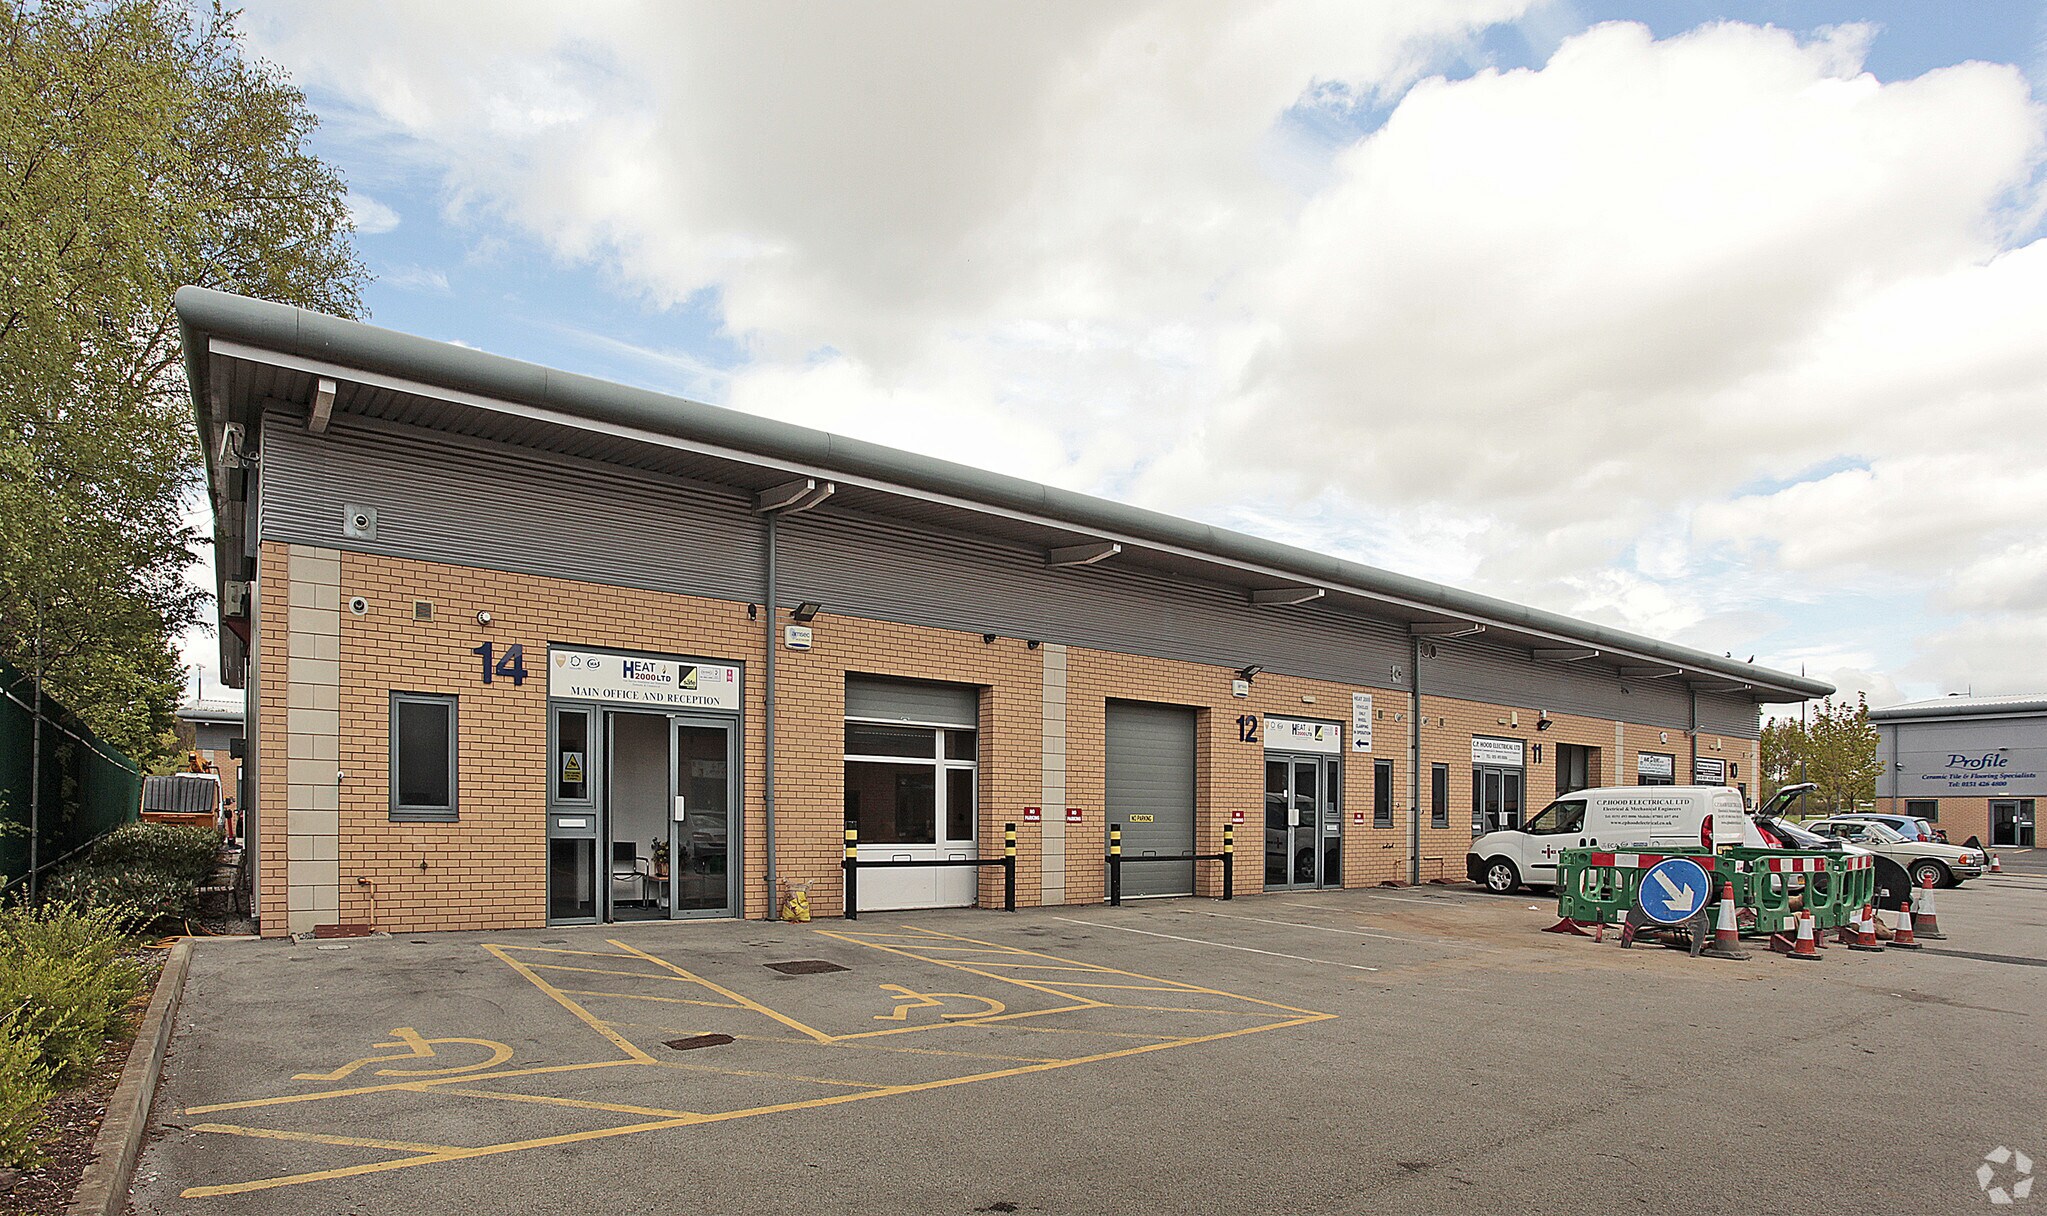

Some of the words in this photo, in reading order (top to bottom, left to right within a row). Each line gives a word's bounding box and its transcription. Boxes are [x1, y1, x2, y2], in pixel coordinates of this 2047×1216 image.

[474, 642, 528, 686] 14
[623, 660, 656, 679] HEAT
[635, 673, 656, 681] 2000
[656, 674, 672, 682] LTD
[571, 686, 600, 697] MAIN
[603, 688, 639, 700] OFFICE
[643, 691, 664, 702] AND
[667, 693, 720, 705] RECEPTION
[1236, 715, 1257, 742] 12
[1945, 753, 2008, 771] Profile
[2000, 772, 2036, 780] Specialists
